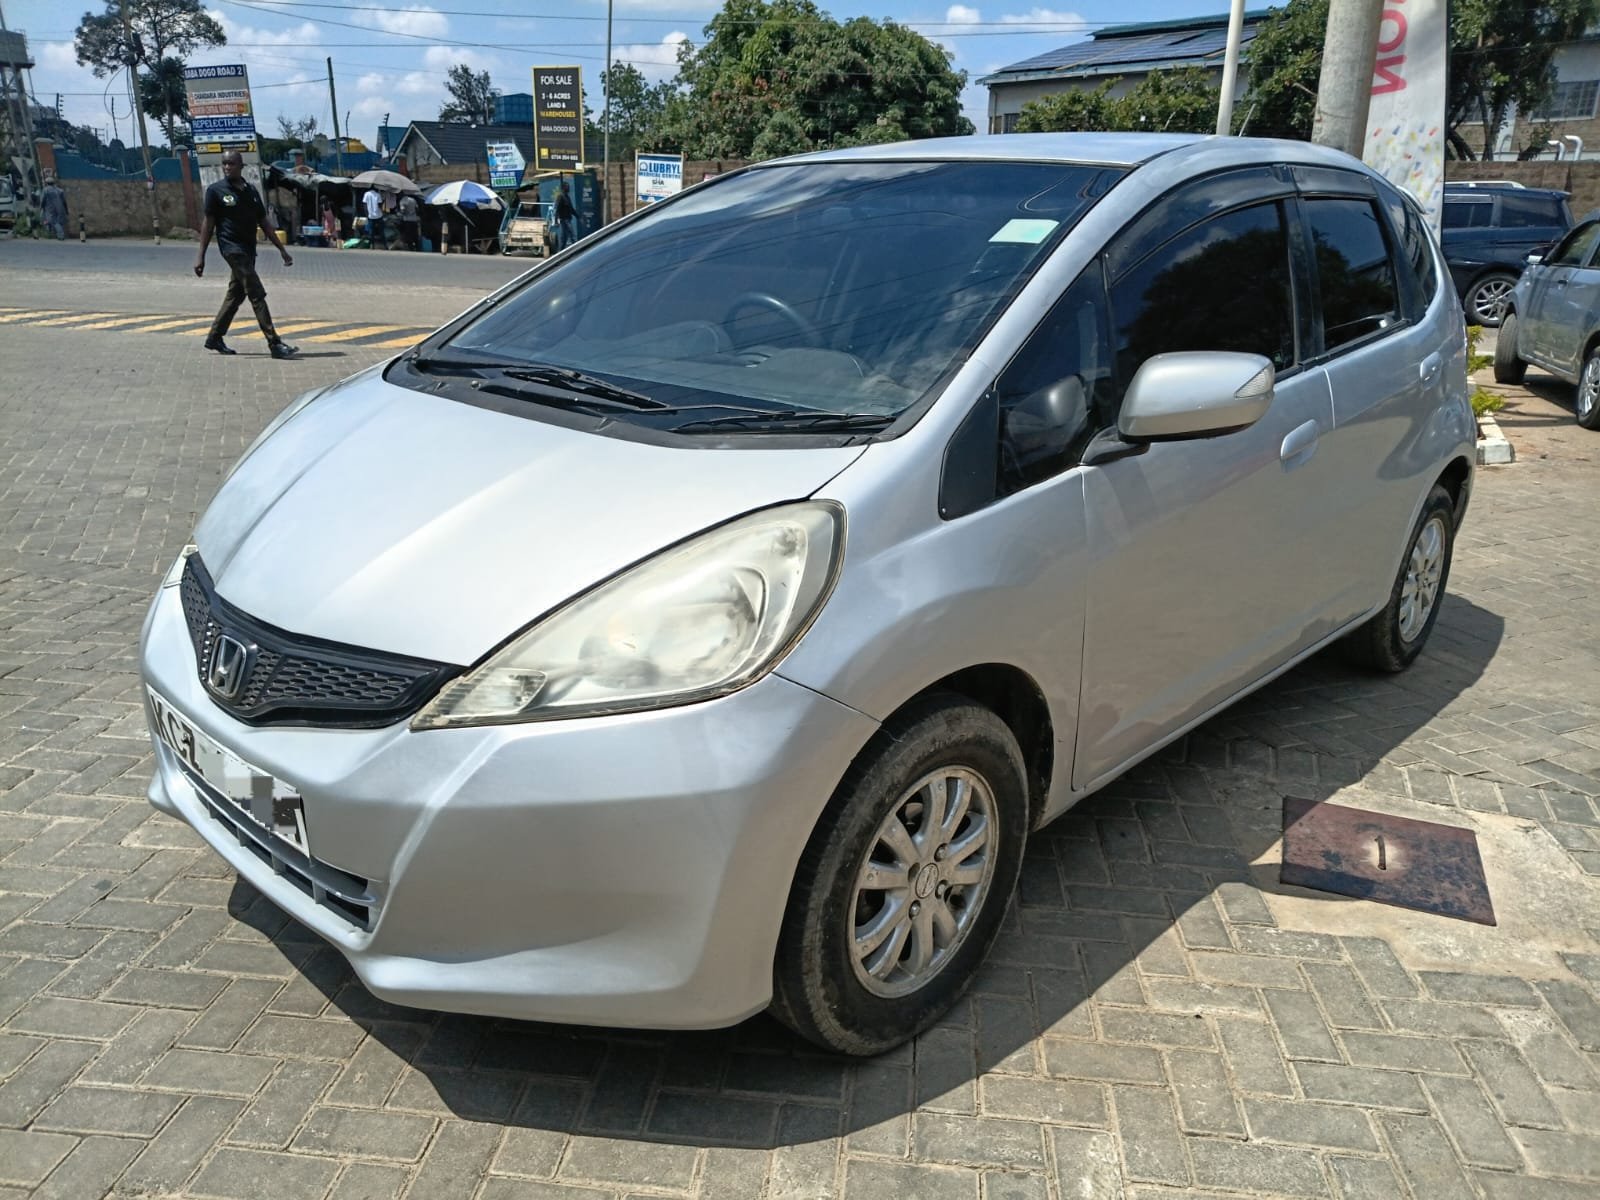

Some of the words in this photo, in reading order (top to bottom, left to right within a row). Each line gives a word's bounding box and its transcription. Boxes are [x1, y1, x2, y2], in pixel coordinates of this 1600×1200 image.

[199, 68, 216, 78] DOGO
[216, 66, 236, 77] ROAD
[237, 66, 243, 75] 2
[540, 75, 555, 85] FOR
[555, 75, 573, 85] SALE
[553, 92, 571, 100] ACRES
